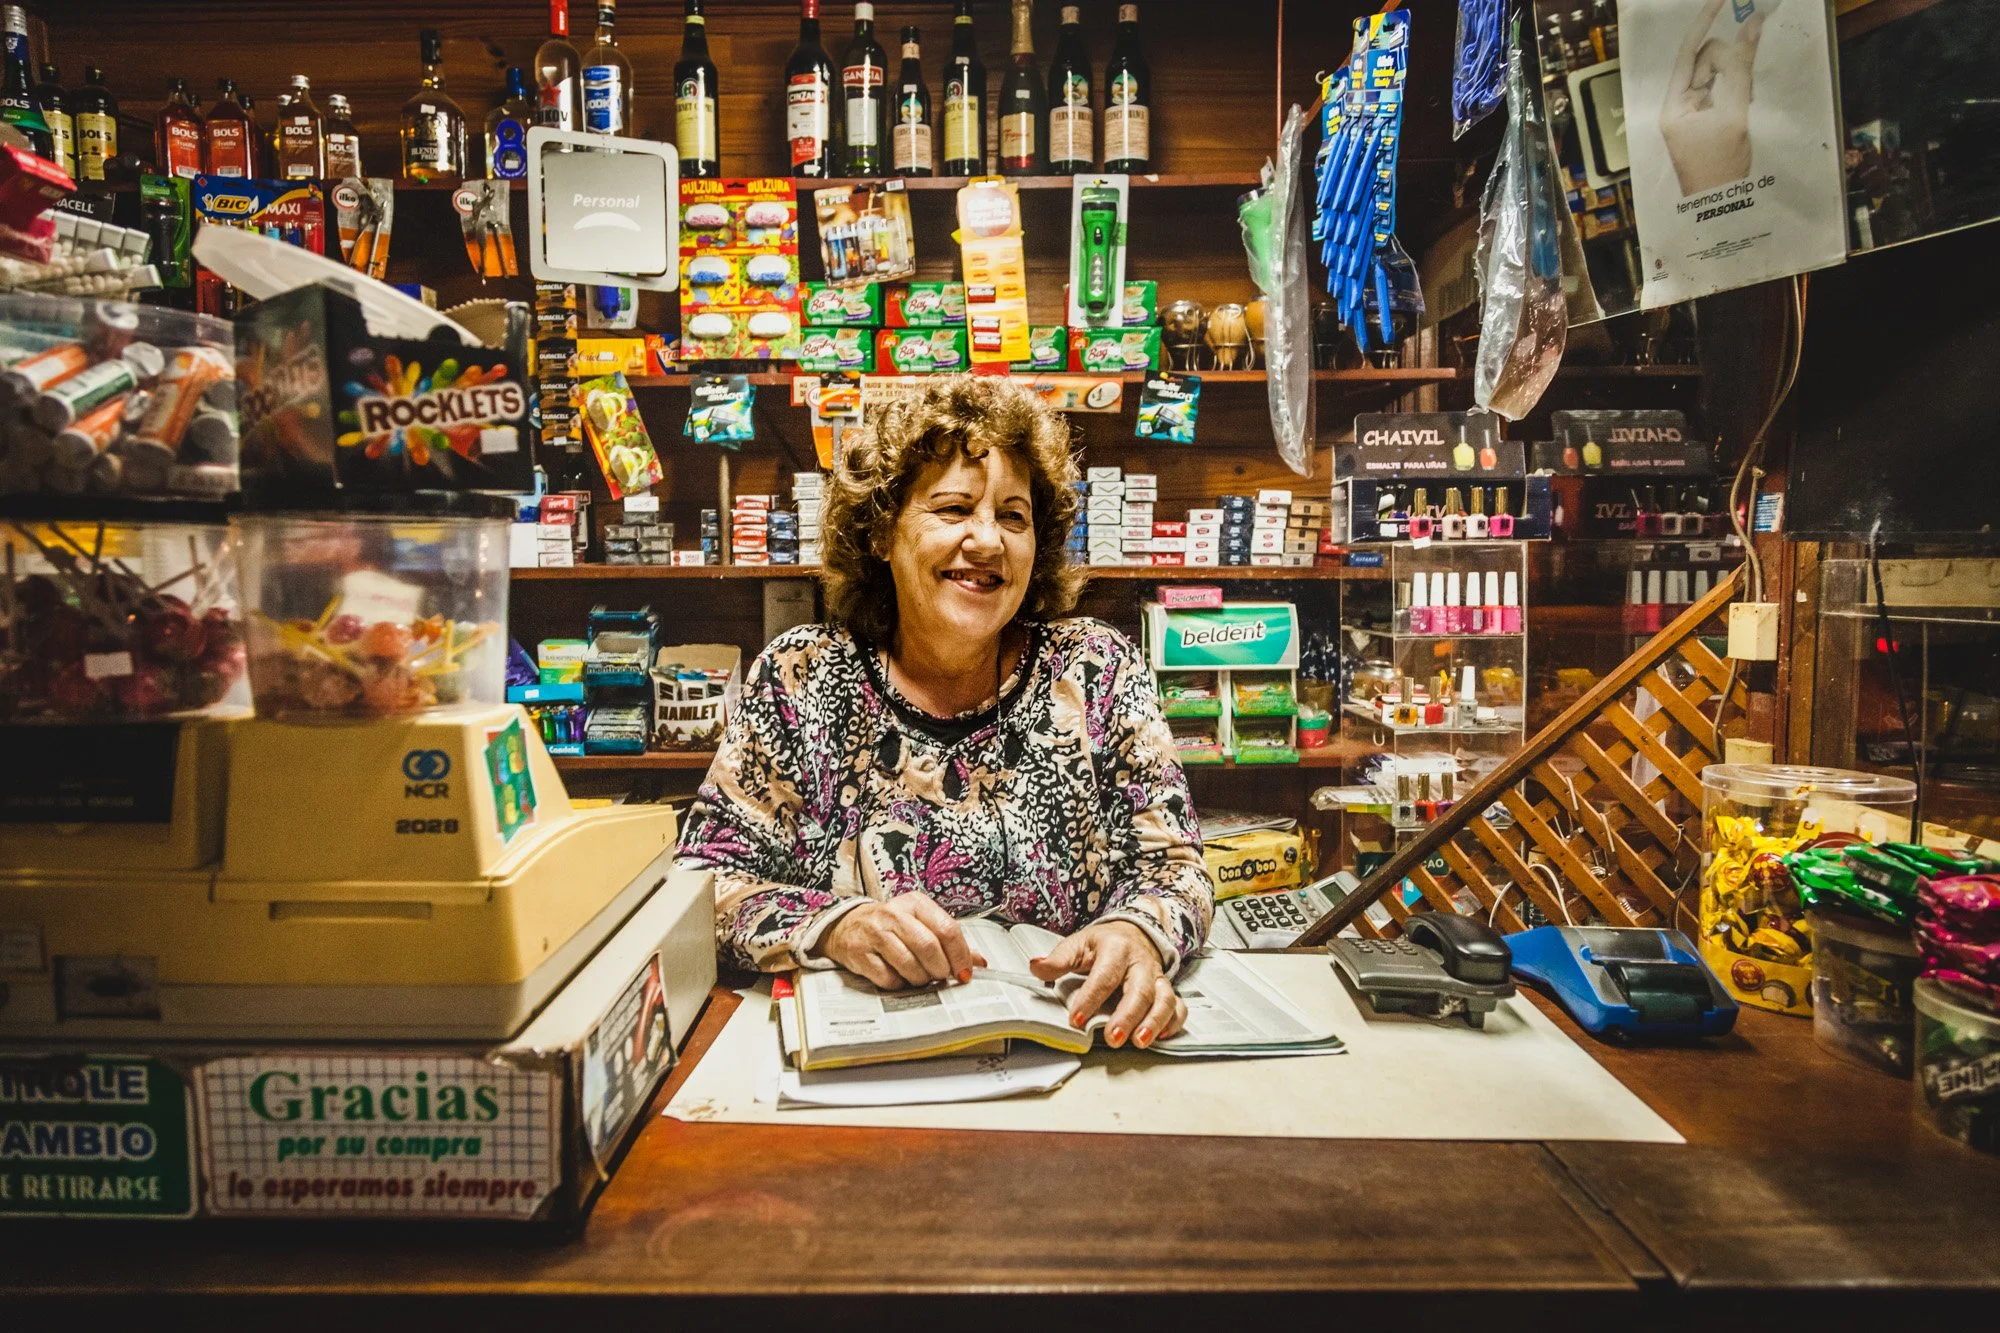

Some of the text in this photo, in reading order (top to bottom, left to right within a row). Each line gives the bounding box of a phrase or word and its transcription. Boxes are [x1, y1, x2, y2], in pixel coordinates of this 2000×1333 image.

[843, 69, 881, 82] GANIA
[1, 98, 30, 109] OLS
[79, 127, 112, 142] BOLS
[172, 127, 199, 139] BOLS
[213, 127, 240, 138] BOLS
[286, 126, 313, 136] BOLS
[327, 143, 354, 153] BOLS
[681, 178, 790, 194] DULZURA DULZURA
[573, 193, 641, 209] Personal
[1676, 174, 1776, 215] tenemos chip de
[217, 199, 248, 210] BIC
[266, 203, 301, 216] MAXI
[1696, 197, 1755, 223] PERSONAL
[363, 385, 523, 434] ROCKLETS
[1363, 429, 1445, 447] CHAIVIL
[1366, 460, 1447, 470] ESMALTE PARA UÑAS
[1171, 593, 1207, 603] beldent
[1183, 621, 1266, 647] beldent
[658, 703, 719, 721] HAMLET
[404, 782, 449, 799] NCR
[395, 817, 459, 835] 2028
[1219, 866, 1242, 882] bon
[1256, 859, 1276, 875] bon
[249, 1070, 500, 1122] Gracias
[277, 1135, 483, 1163] por su compra
[22, 1173, 162, 1201] RETIRARSE
[227, 1170, 537, 1206] le esperamos siempre
